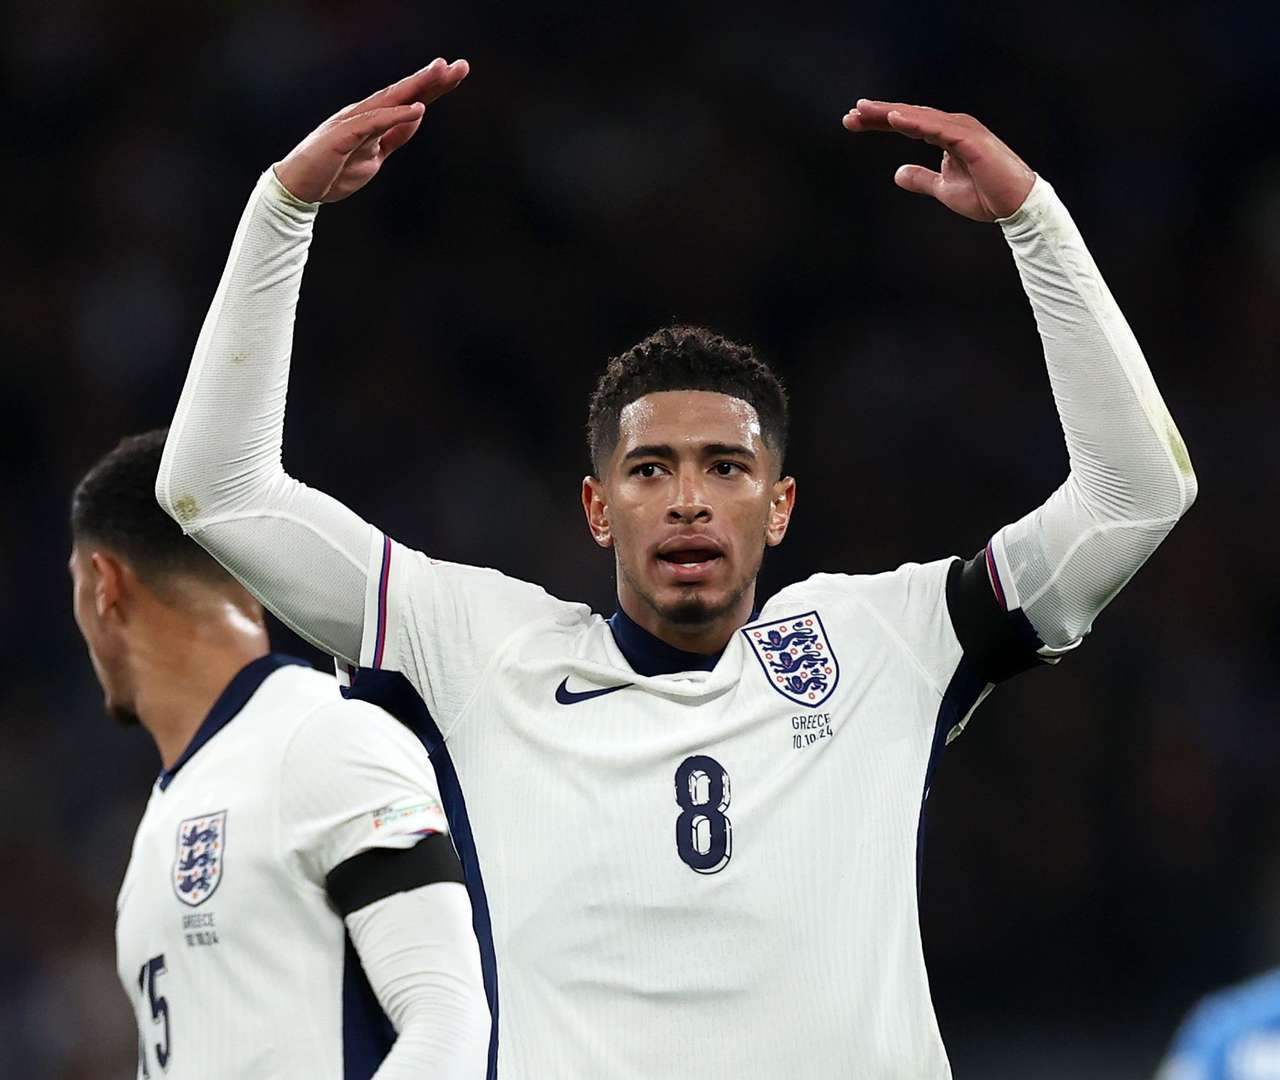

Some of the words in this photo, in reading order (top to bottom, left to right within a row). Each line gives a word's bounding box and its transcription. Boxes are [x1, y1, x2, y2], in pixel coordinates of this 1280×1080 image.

[792, 713, 831, 730] GREECE
[793, 725, 833, 749] 10.10.24
[674, 755, 732, 875] 8
